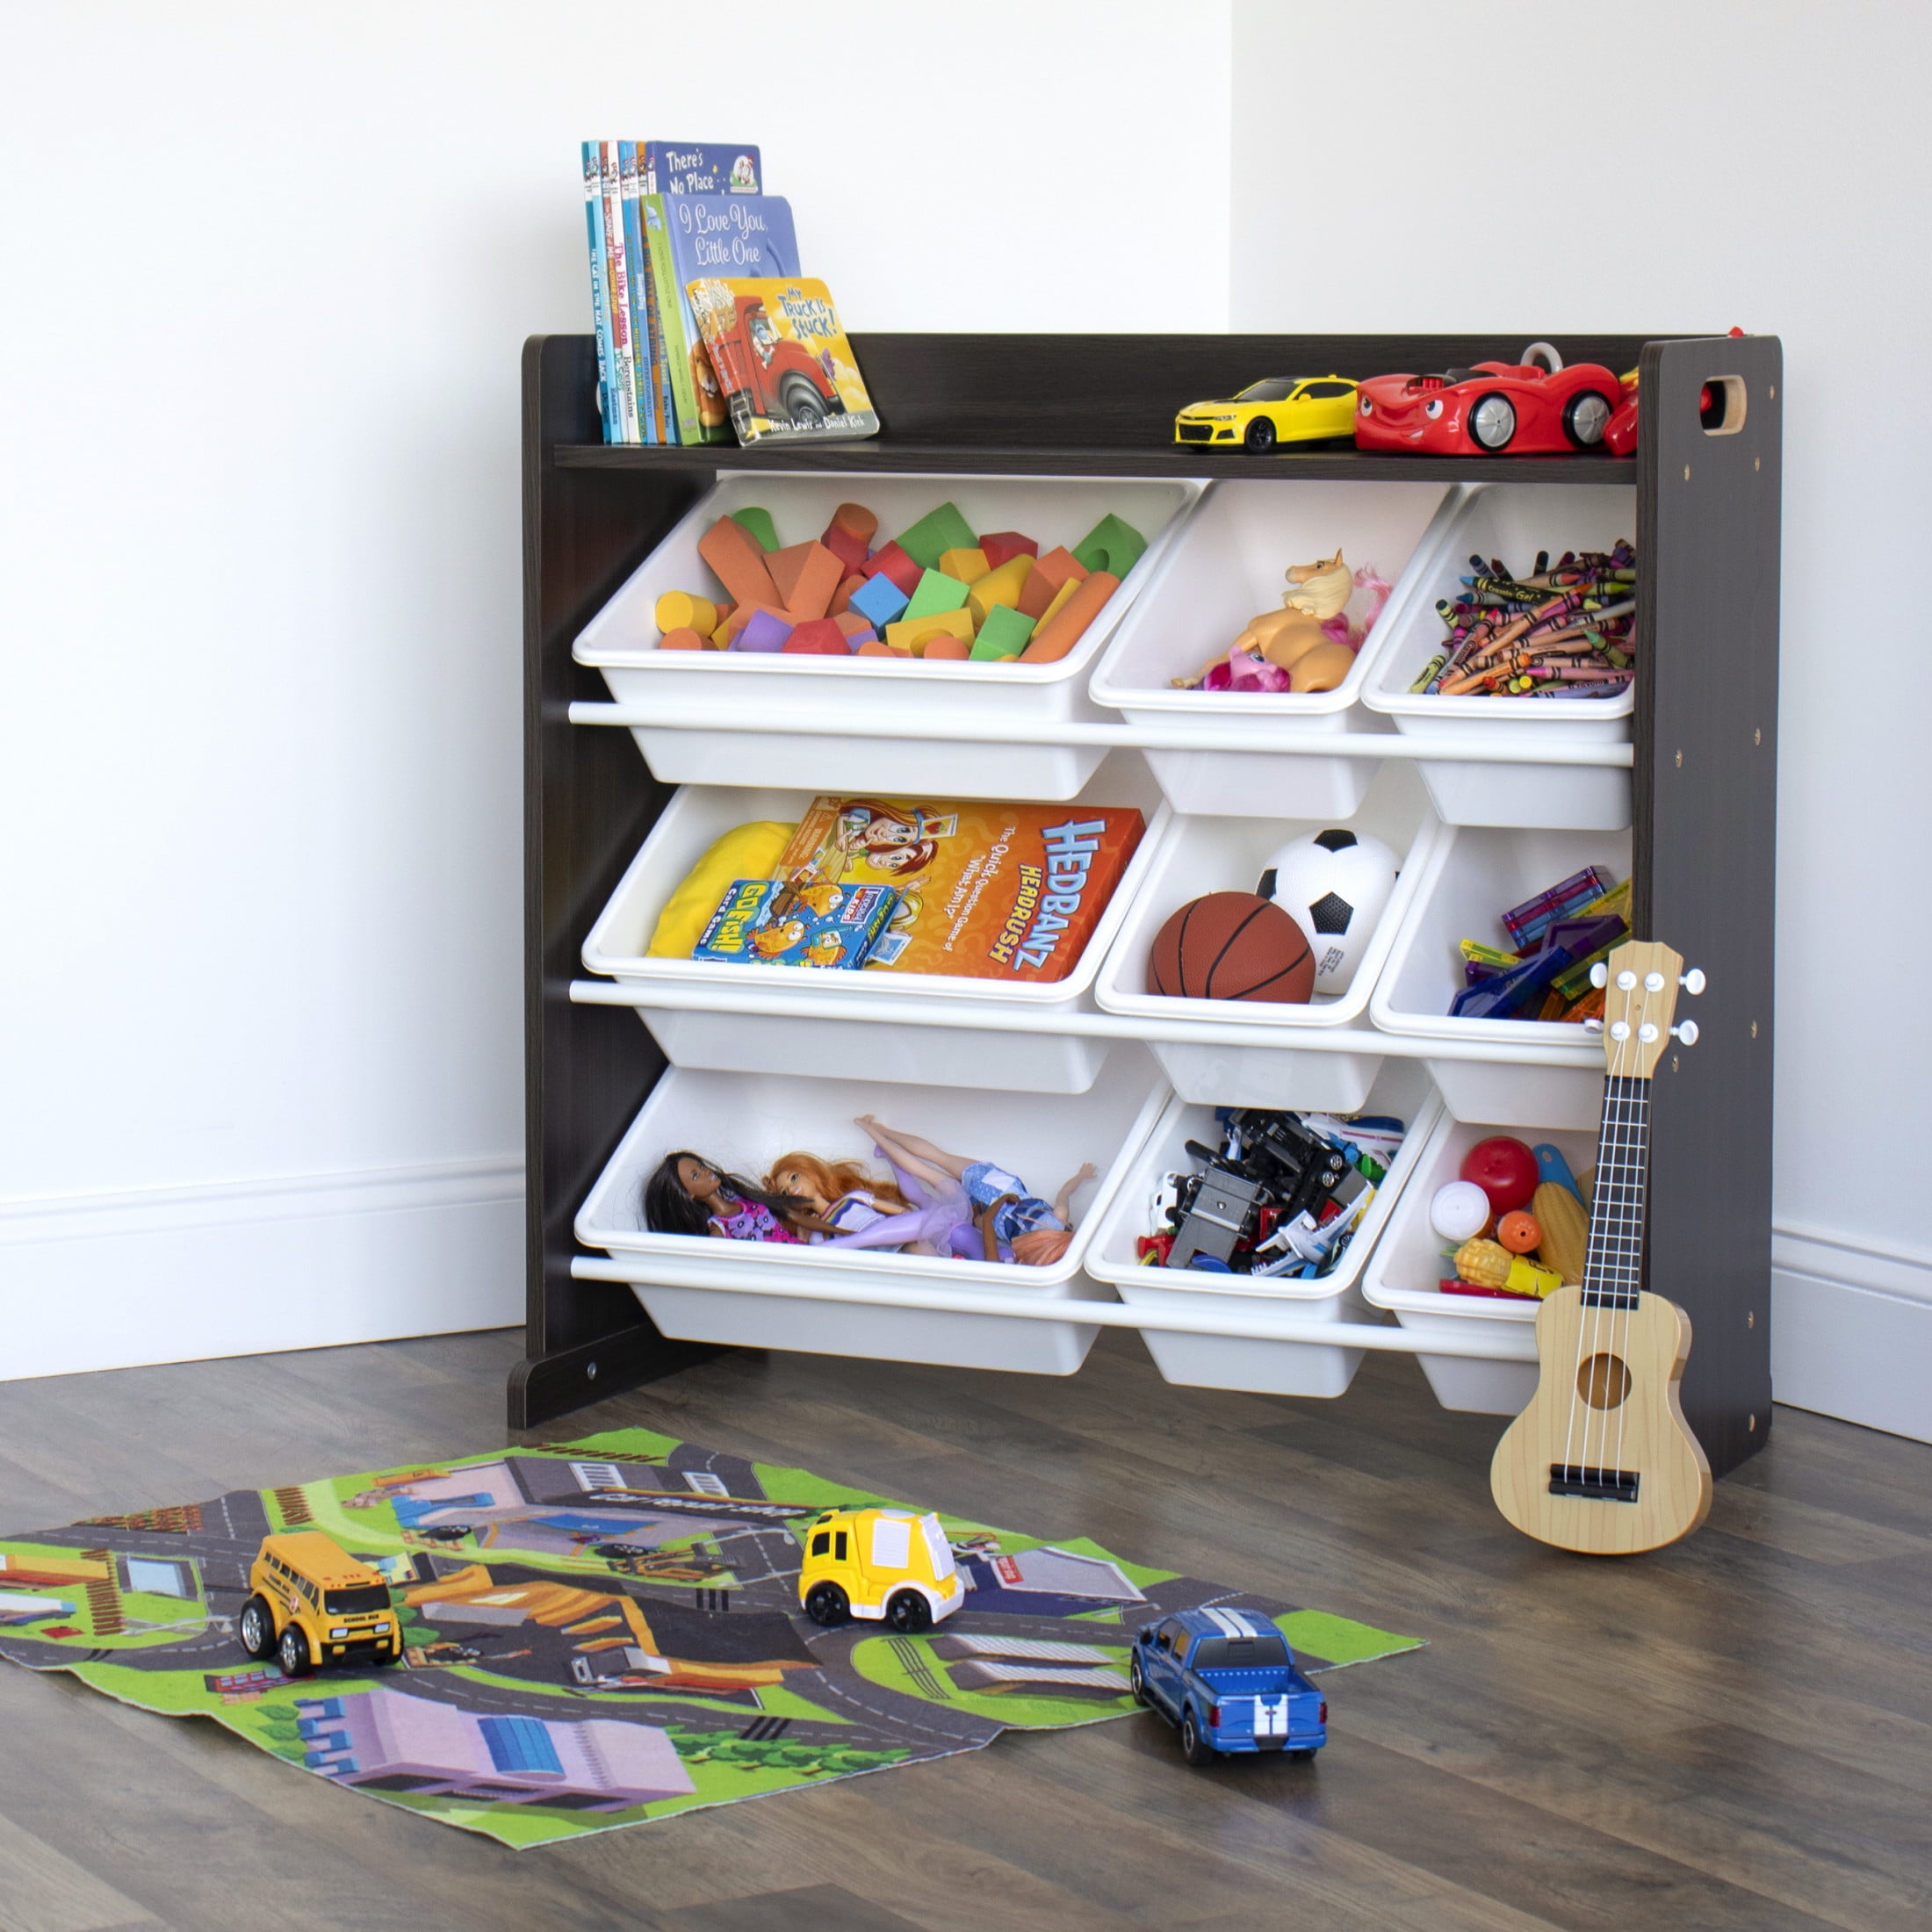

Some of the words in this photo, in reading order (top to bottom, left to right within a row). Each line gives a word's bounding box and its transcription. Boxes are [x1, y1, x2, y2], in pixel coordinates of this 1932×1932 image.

[666, 148, 703, 173] There's
[670, 176, 684, 194] No
[686, 171, 714, 193] Place
[679, 203, 692, 234] I
[695, 203, 731, 234] Love
[729, 203, 768, 240] You,
[615, 243, 624, 267] The
[695, 236, 731, 265] Little
[732, 235, 761, 265] One
[594, 280, 599, 290] IN
[616, 271, 625, 299] Bike
[619, 303, 628, 345] Lesson
[596, 328, 605, 357] COMES
[598, 360, 607, 382] BACK
[624, 356, 634, 419] Berenstains
[768, 419, 790, 432] Kevin
[790, 417, 813, 431] Lewis
[823, 415, 847, 429] Daniel
[847, 415, 865, 429] Kirk
[1517, 591, 1533, 602] Gel
[999, 826, 1016, 842] The
[980, 844, 1009, 878] Quick
[718, 888, 738, 913] Card
[737, 883, 767, 910] GO
[951, 885, 968, 904] Am
[962, 878, 989, 916] Question
[1013, 818, 1107, 971] HEDBANZ
[844, 898, 860, 920] KIDS
[988, 864, 1042, 964] HEADRUSH
[700, 915, 721, 946] Game
[948, 916, 969, 941] Game
[943, 942, 954, 952] of
[343, 1615, 366, 1624] SCHOOL
